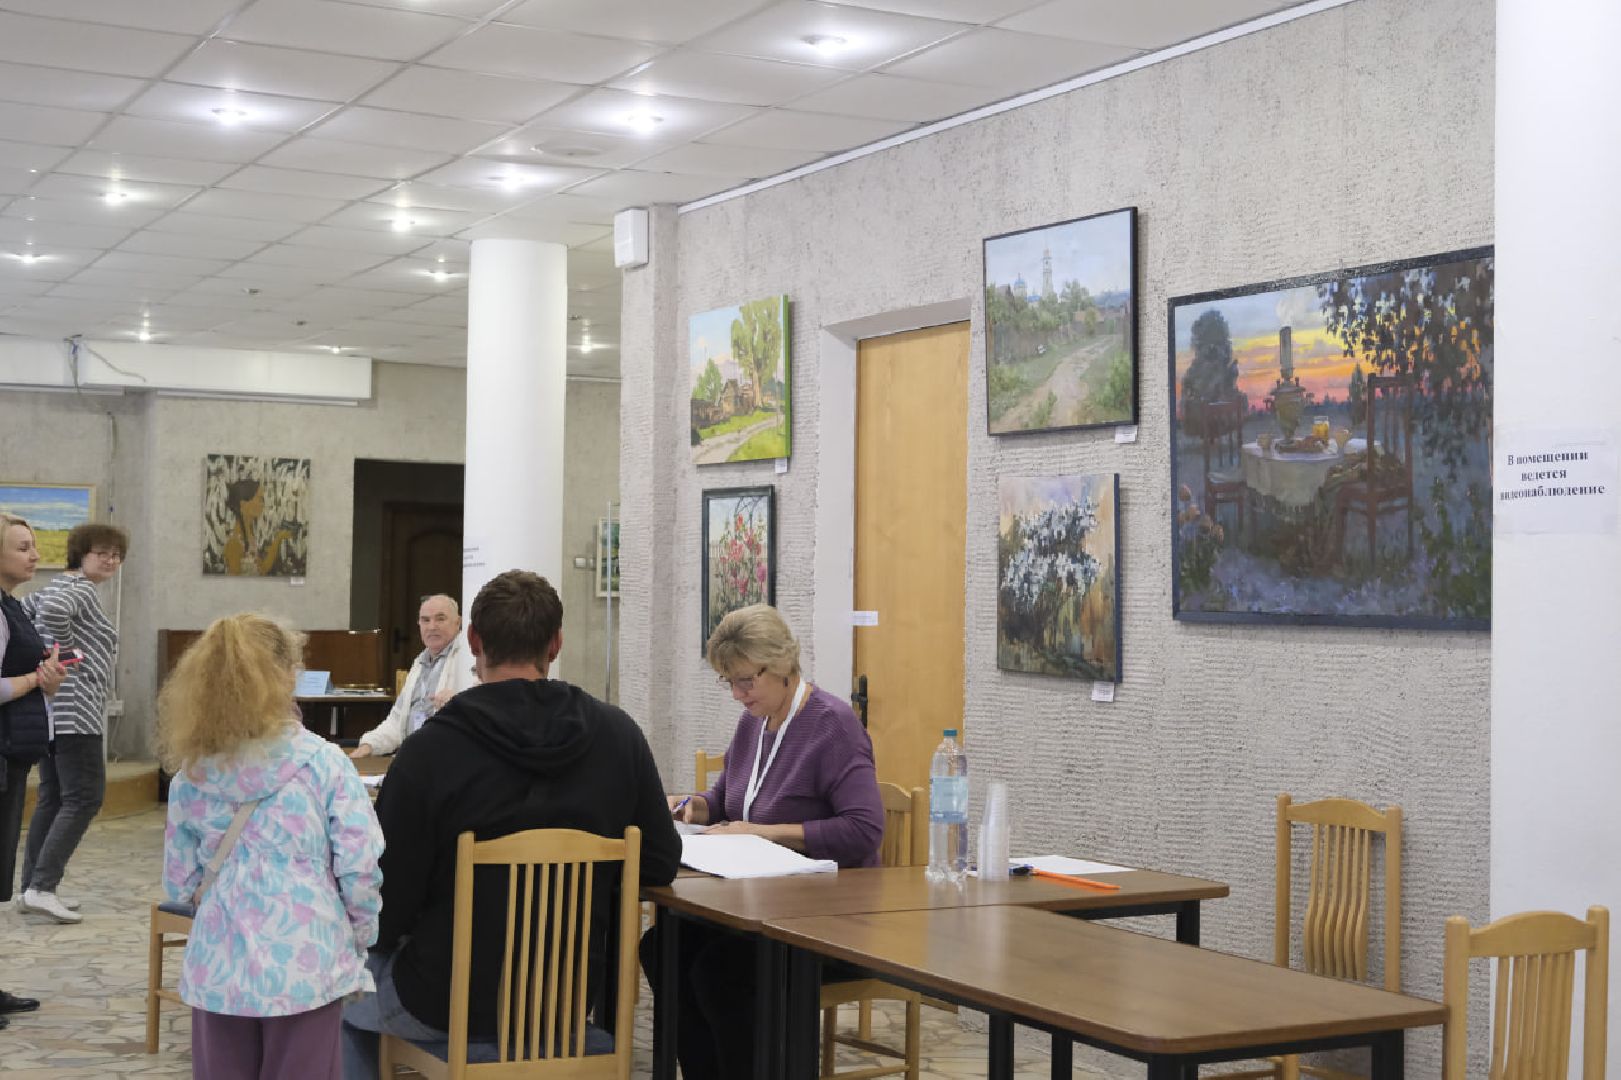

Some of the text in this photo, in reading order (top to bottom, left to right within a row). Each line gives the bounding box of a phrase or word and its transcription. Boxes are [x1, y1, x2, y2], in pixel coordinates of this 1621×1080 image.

[1507, 452, 1589, 466] В помещении
[1521, 469, 1567, 481] ведется
